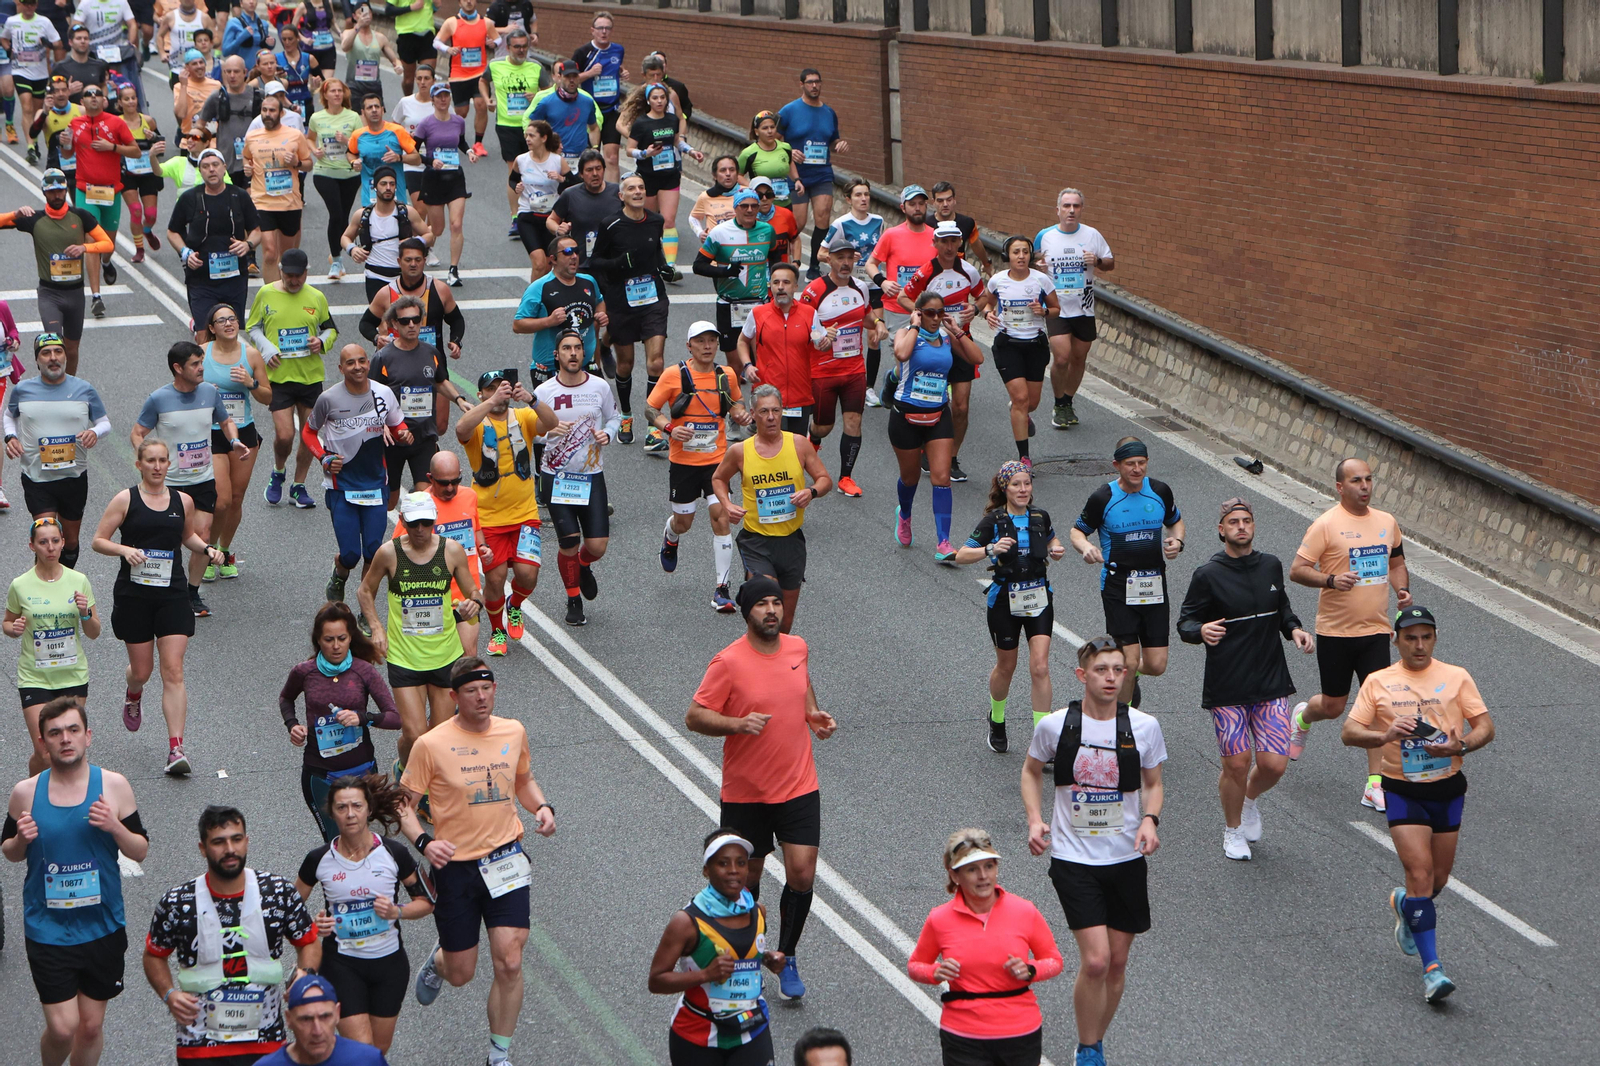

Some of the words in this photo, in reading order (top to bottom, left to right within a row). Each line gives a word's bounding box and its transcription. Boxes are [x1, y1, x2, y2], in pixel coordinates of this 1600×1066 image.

[751, 471, 794, 486] BRASIL
[768, 487, 792, 496] ZURICH
[447, 522, 468, 530] ZURICH
[399, 580, 447, 592] DEPORTEMANIA
[47, 642, 64, 650] 10112
[1392, 699, 1416, 707] Maratón
[329, 728, 345, 738] 1172
[461, 765, 486, 773] Maratón
[1090, 794, 1120, 802] ZURICH
[1089, 809, 1108, 817] 9817
[492, 846, 517, 862] ZURICH
[61, 862, 92, 872] ZURICH
[332, 872, 346, 883] edp
[60, 878, 84, 888] 10877
[350, 886, 370, 898] edp
[350, 900, 374, 912] ZURIC
[350, 916, 372, 928] 11760
[349, 928, 370, 938] MARITA
[734, 962, 758, 970] ZURICH
[728, 979, 750, 988] 10646
[226, 992, 258, 1002] ZURICH
[730, 992, 748, 1000] ZIPPS
[225, 1010, 245, 1019] 9016
